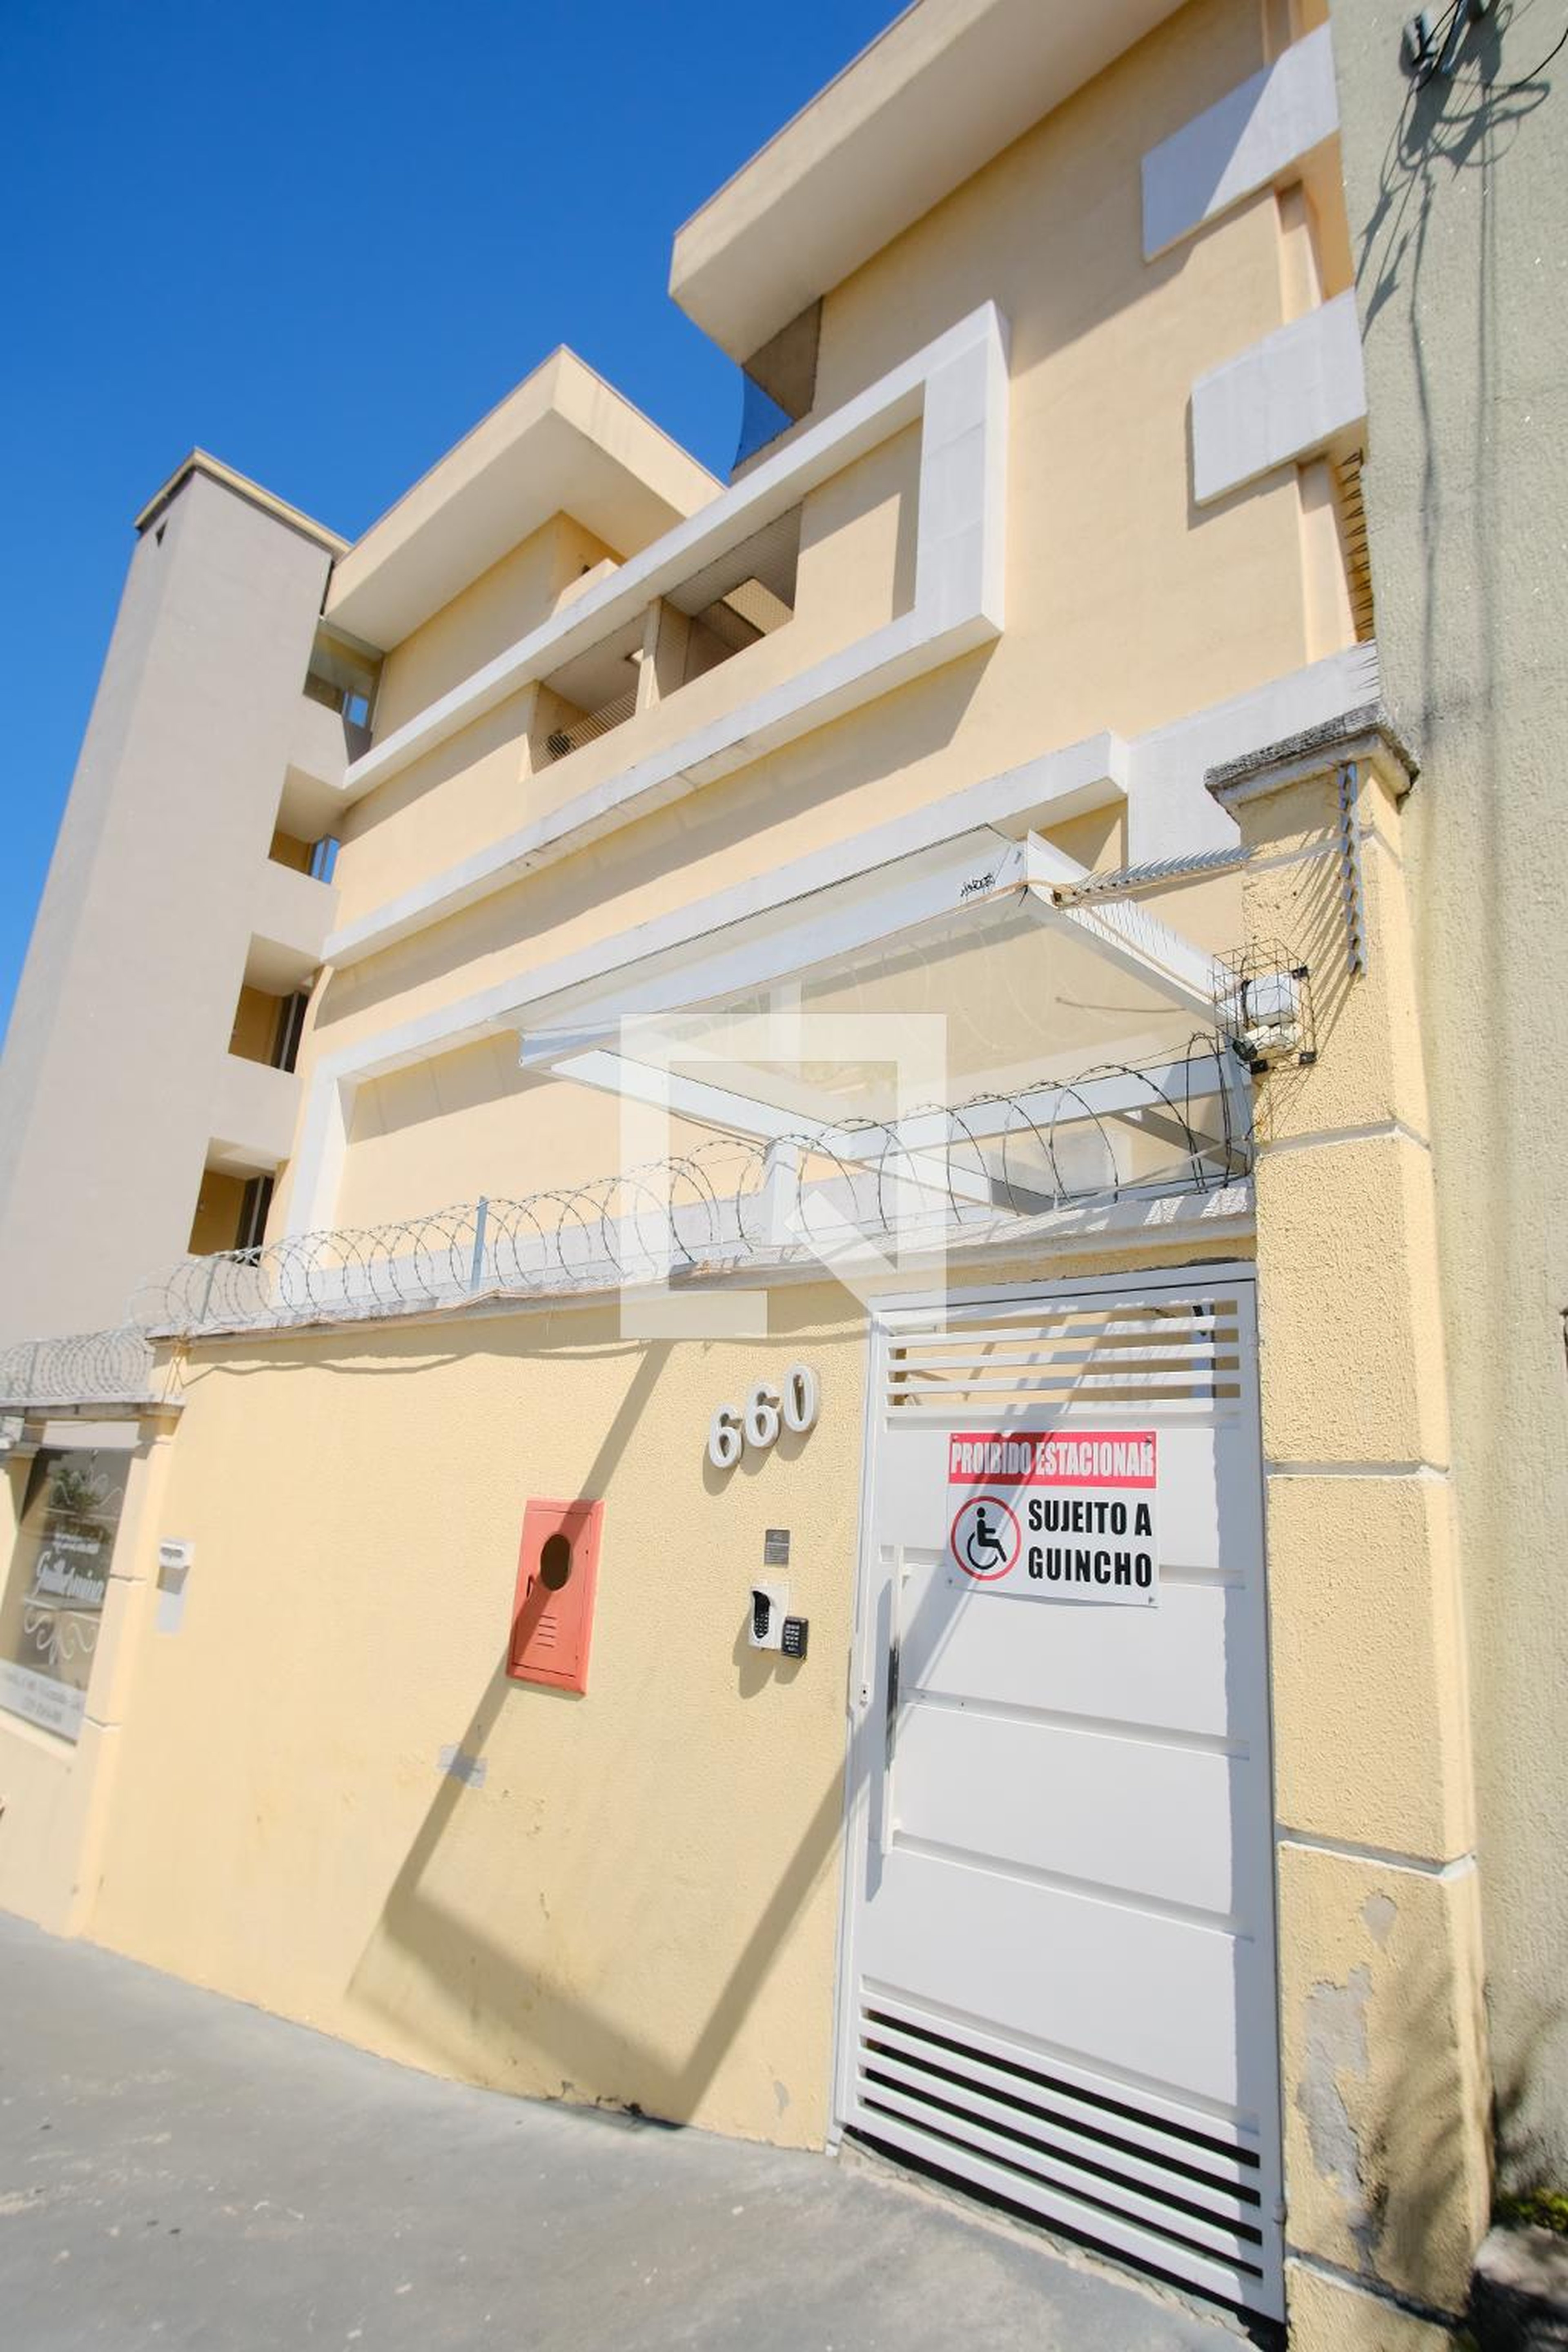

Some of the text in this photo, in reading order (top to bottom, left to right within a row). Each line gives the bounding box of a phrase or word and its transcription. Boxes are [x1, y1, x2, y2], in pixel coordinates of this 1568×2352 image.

[708, 1364, 819, 1468] 660
[951, 1441, 1154, 1476] PROIBIDO ESTACIONAR
[1029, 1499, 1152, 1536] SUJEITO A
[1029, 1547, 1152, 1588] GUINCHO
